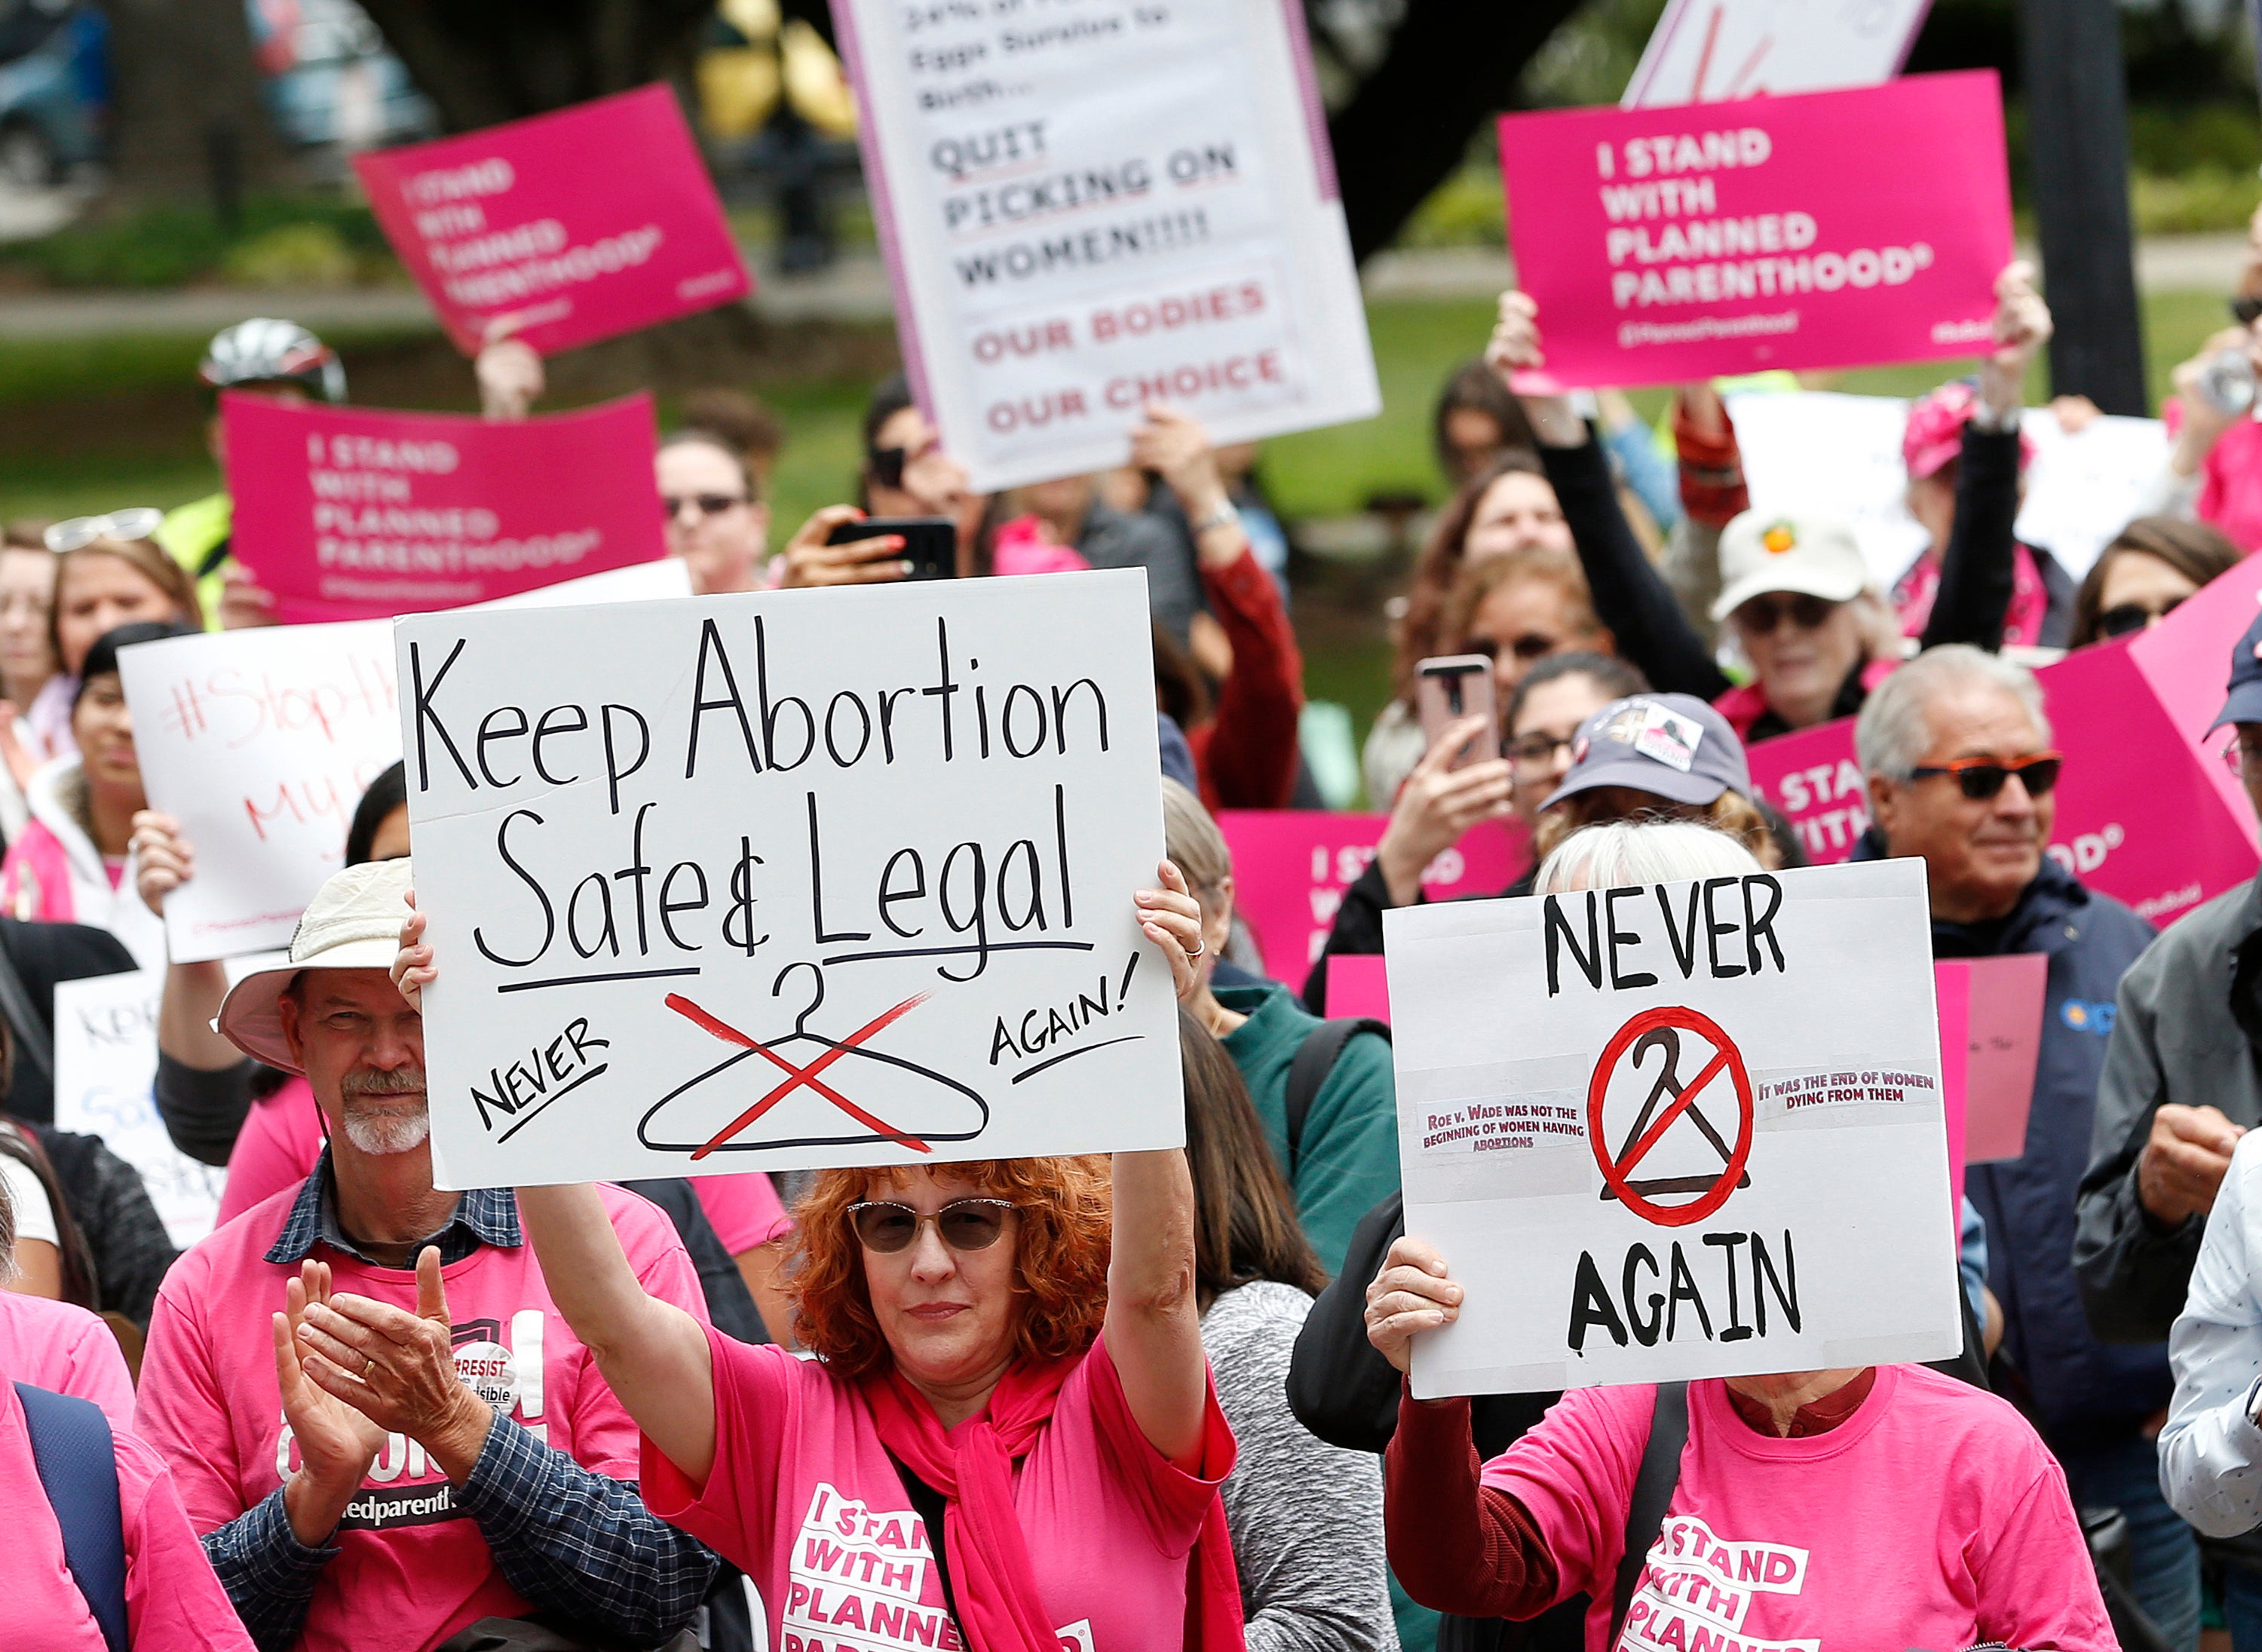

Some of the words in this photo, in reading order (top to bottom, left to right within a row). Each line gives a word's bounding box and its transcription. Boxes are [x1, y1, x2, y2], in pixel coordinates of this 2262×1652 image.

[930, 117, 1049, 179] QUIT
[1596, 140, 1614, 179] I
[1623, 127, 1773, 177] STAND
[941, 156, 1152, 231] PICKING
[1165, 141, 1237, 185] ON
[1598, 176, 1718, 222] WITH
[1606, 210, 1819, 267] PLANNED
[972, 319, 1074, 365] OUR
[1090, 280, 1268, 345] BODIES
[986, 387, 1087, 434] OUR
[1104, 347, 1285, 409] CHOICE
[329, 433, 460, 474] STAND
[310, 469, 412, 504] WITH
[312, 501, 501, 540] PLANNED
[410, 638, 651, 815] Keep
[685, 615, 1109, 779] Abortion
[473, 801, 709, 967] Safe
[806, 783, 1073, 982] Legal
[1543, 873, 1785, 999] NEVER
[470, 1016, 611, 1132] NEVER
[988, 950, 1142, 1066] AGAIN!
[1773, 1078, 1801, 1096] WAS
[1803, 1074, 1828, 1090] THE
[1830, 1071, 1858, 1087] END
[1860, 1071, 1879, 1085] OF
[1881, 1071, 1935, 1090] WOMEN
[1786, 1090, 1825, 1110] DYING
[1828, 1088, 1865, 1103] FROM
[1868, 1088, 1905, 1102] THEM
[1424, 1123, 1480, 1149] BEGINNING
[1482, 1122, 1497, 1135] OF
[1498, 1120, 1540, 1133] WOMEN
[1543, 1121, 1585, 1137] HAVING
[1505, 1105, 1528, 1117] WAS
[1531, 1105, 1553, 1117] NOT
[1556, 1107, 1577, 1120] THE
[1473, 1136, 1534, 1152] ABORTIONS
[1568, 1228, 1802, 1354] AGAIN
[813, 1490, 831, 1522] I
[804, 1537, 914, 1593] WITH
[1672, 1523, 1797, 1585] STAND
